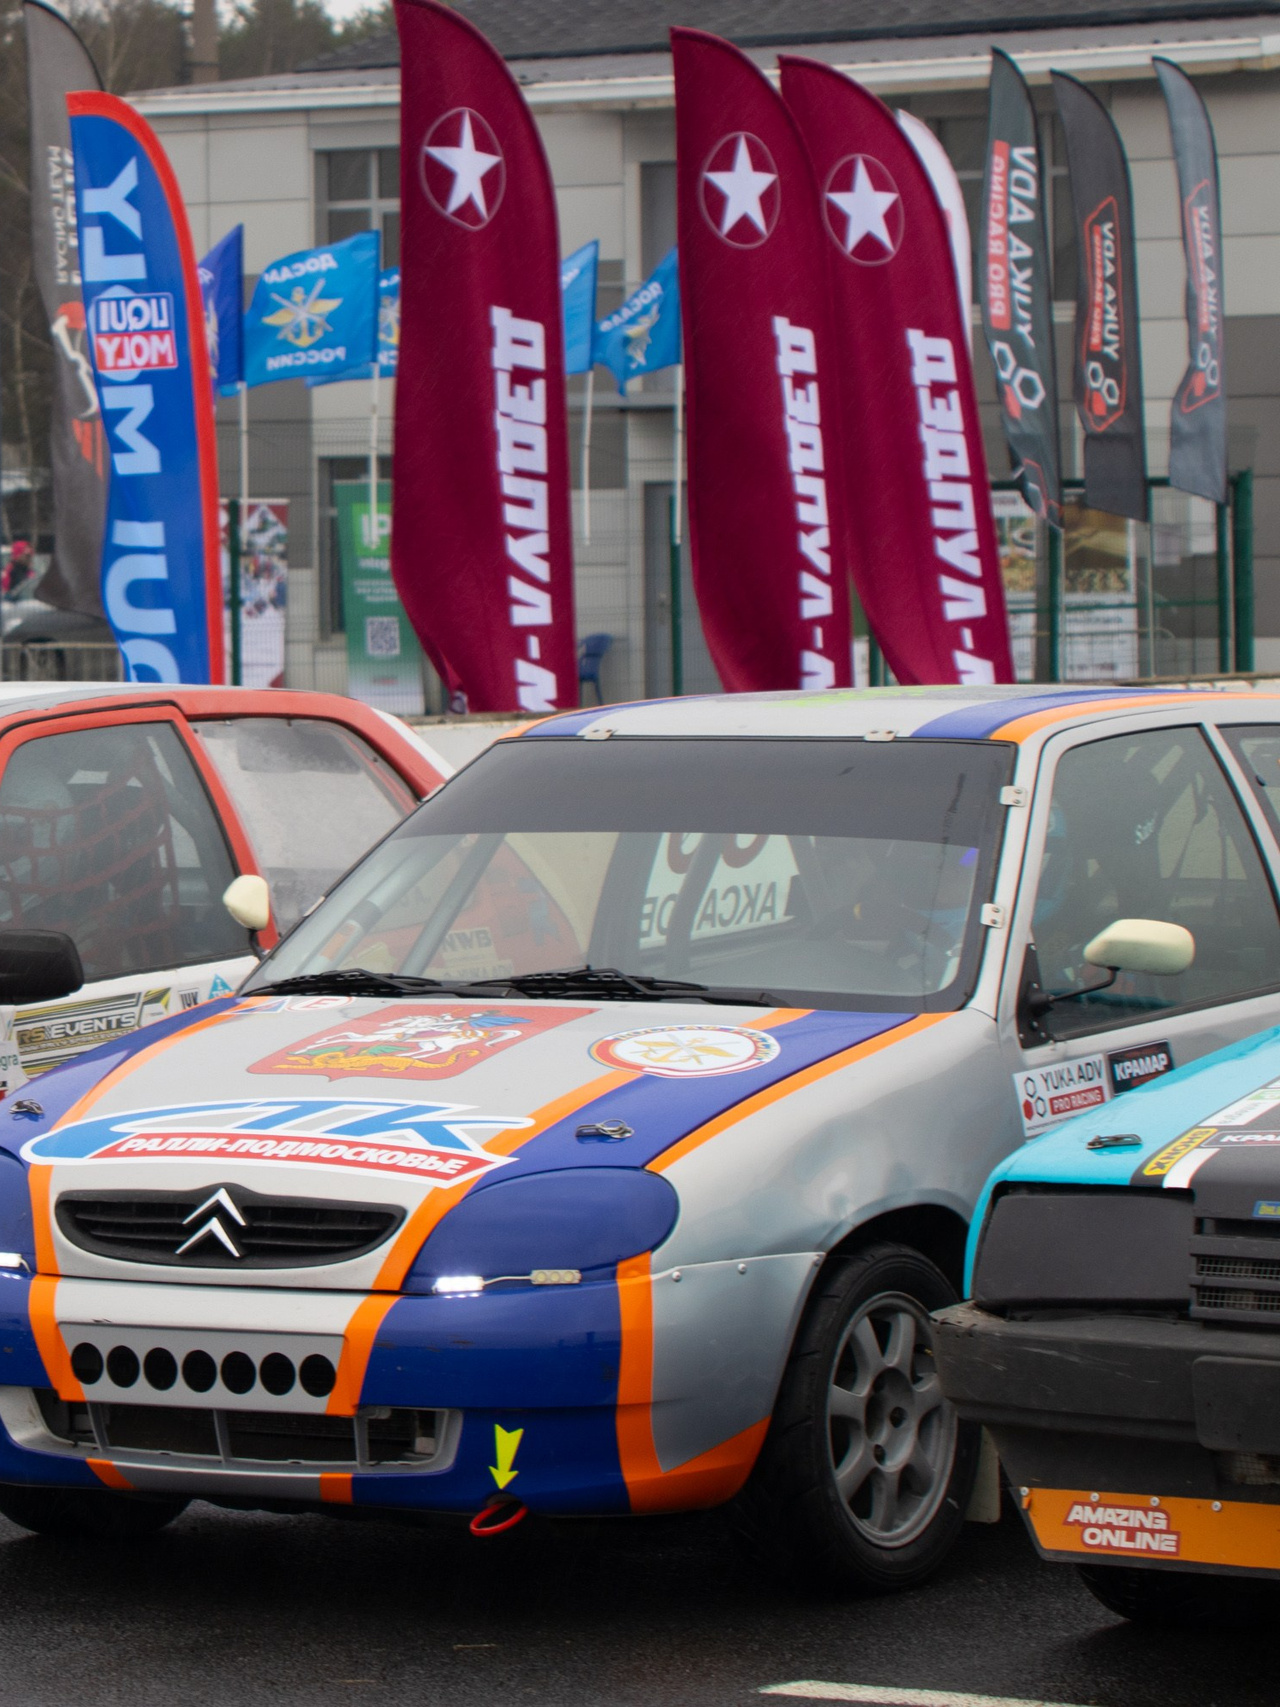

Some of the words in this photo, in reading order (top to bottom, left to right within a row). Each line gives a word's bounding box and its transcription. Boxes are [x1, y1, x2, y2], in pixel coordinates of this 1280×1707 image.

[50, 1012, 137, 1039] EVENTS
[1040, 1065, 1076, 1092] YUKA
[1077, 1059, 1103, 1082] ADV
[1114, 1053, 1169, 1082] КРАМАР
[1053, 1097, 1071, 1112] PRO
[1072, 1090, 1102, 1108] RACING
[116, 1136, 469, 1176] РАЛЛИ-ПОДМОСКОВЬЕ
[1067, 1504, 1168, 1530] AMAZING
[1083, 1527, 1179, 1552] ONLINE
